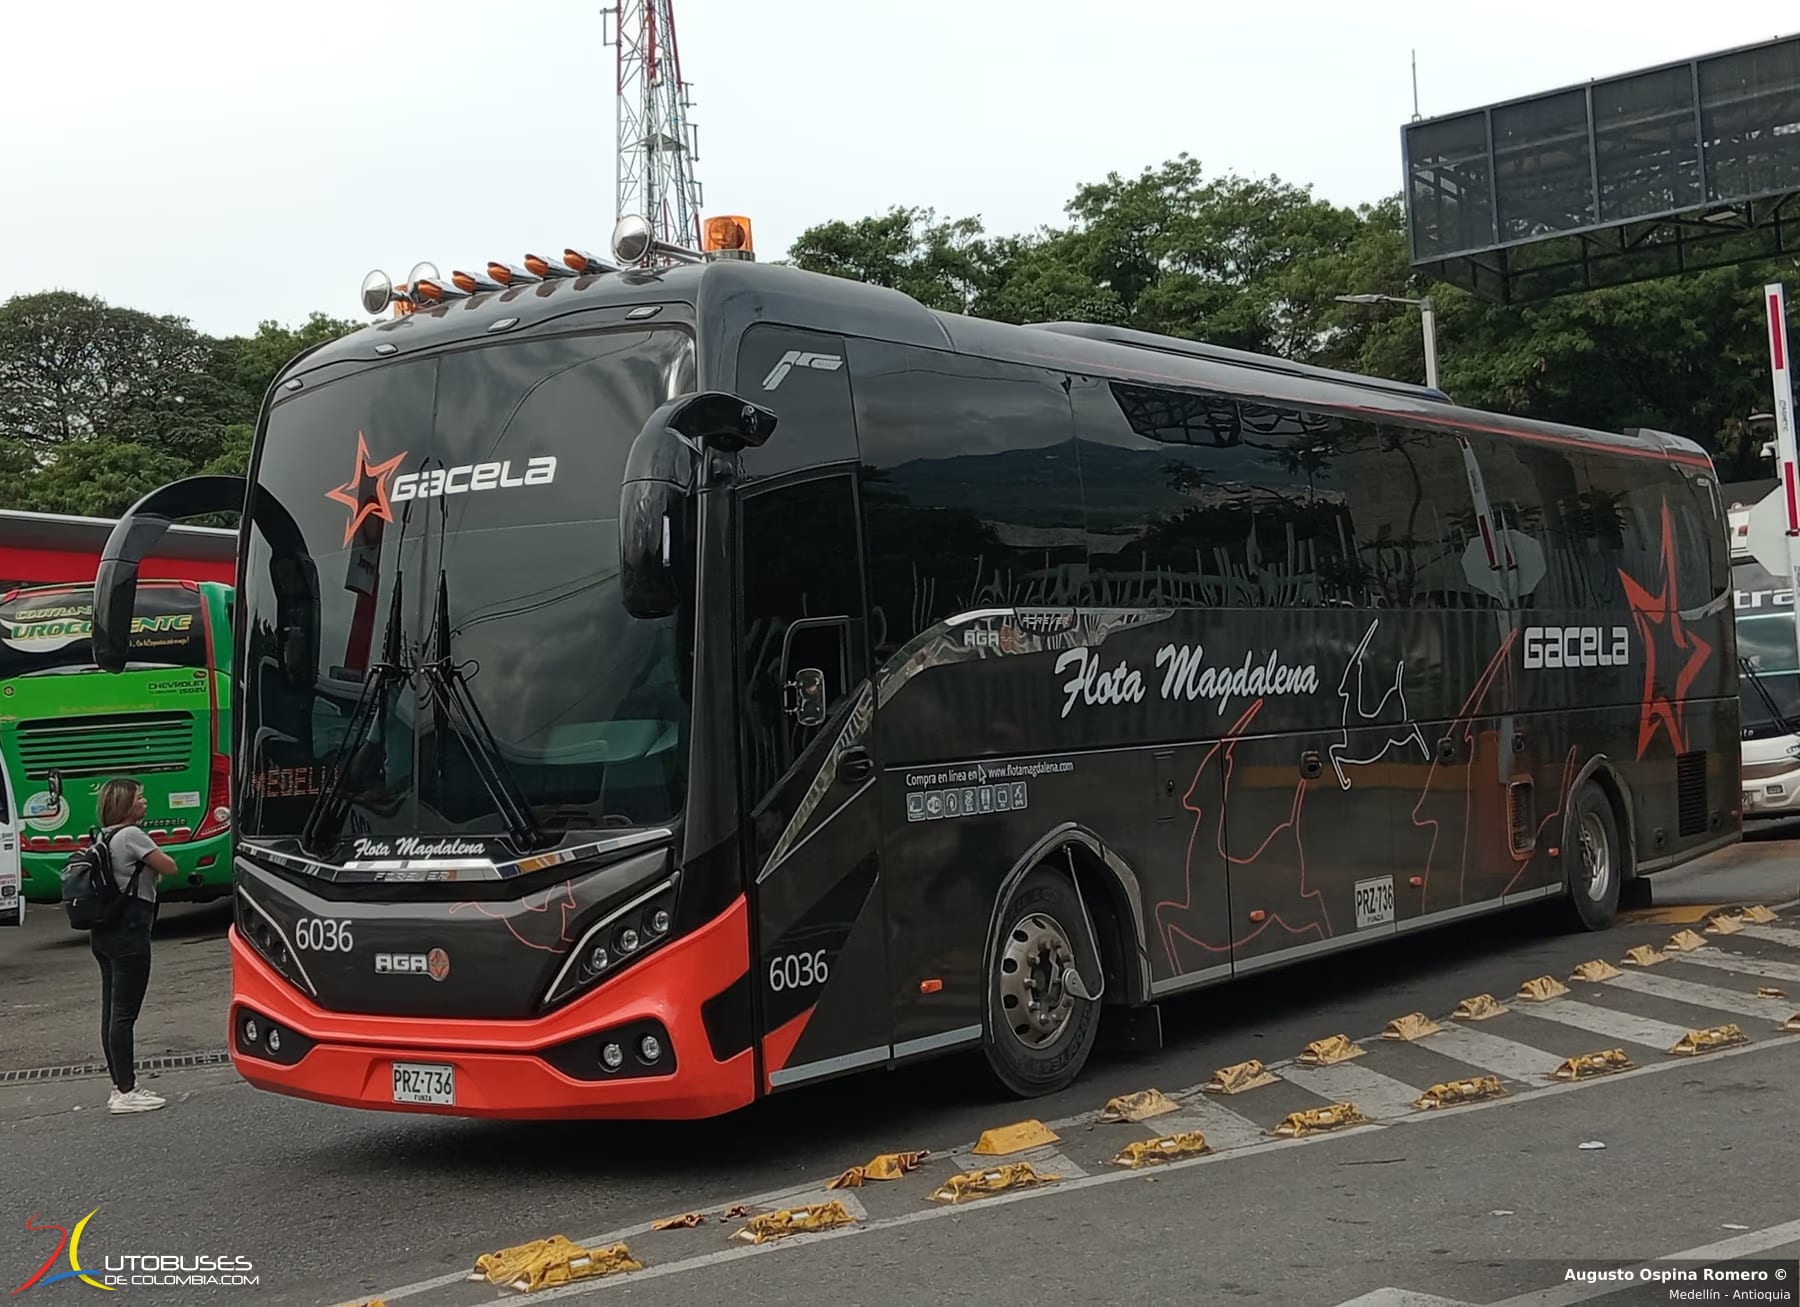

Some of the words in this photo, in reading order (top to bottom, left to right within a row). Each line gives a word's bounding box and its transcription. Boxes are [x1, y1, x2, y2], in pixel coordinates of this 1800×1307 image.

[963, 629, 1000, 648] AGA
[147, 680, 206, 691] CHEVROLET
[1054, 646, 1146, 719] Flota
[1155, 643, 1320, 716] Magdalena
[906, 772, 936, 788] Compra
[938, 773, 948, 783] en
[968, 769, 978, 780] en
[988, 760, 1074, 778] www.flotamagdalena.com
[353, 838, 391, 859] Flota
[395, 837, 486, 860] Magdalena
[295, 918, 353, 952] 6036
[375, 953, 428, 974] AGA
[769, 949, 829, 991] 6036
